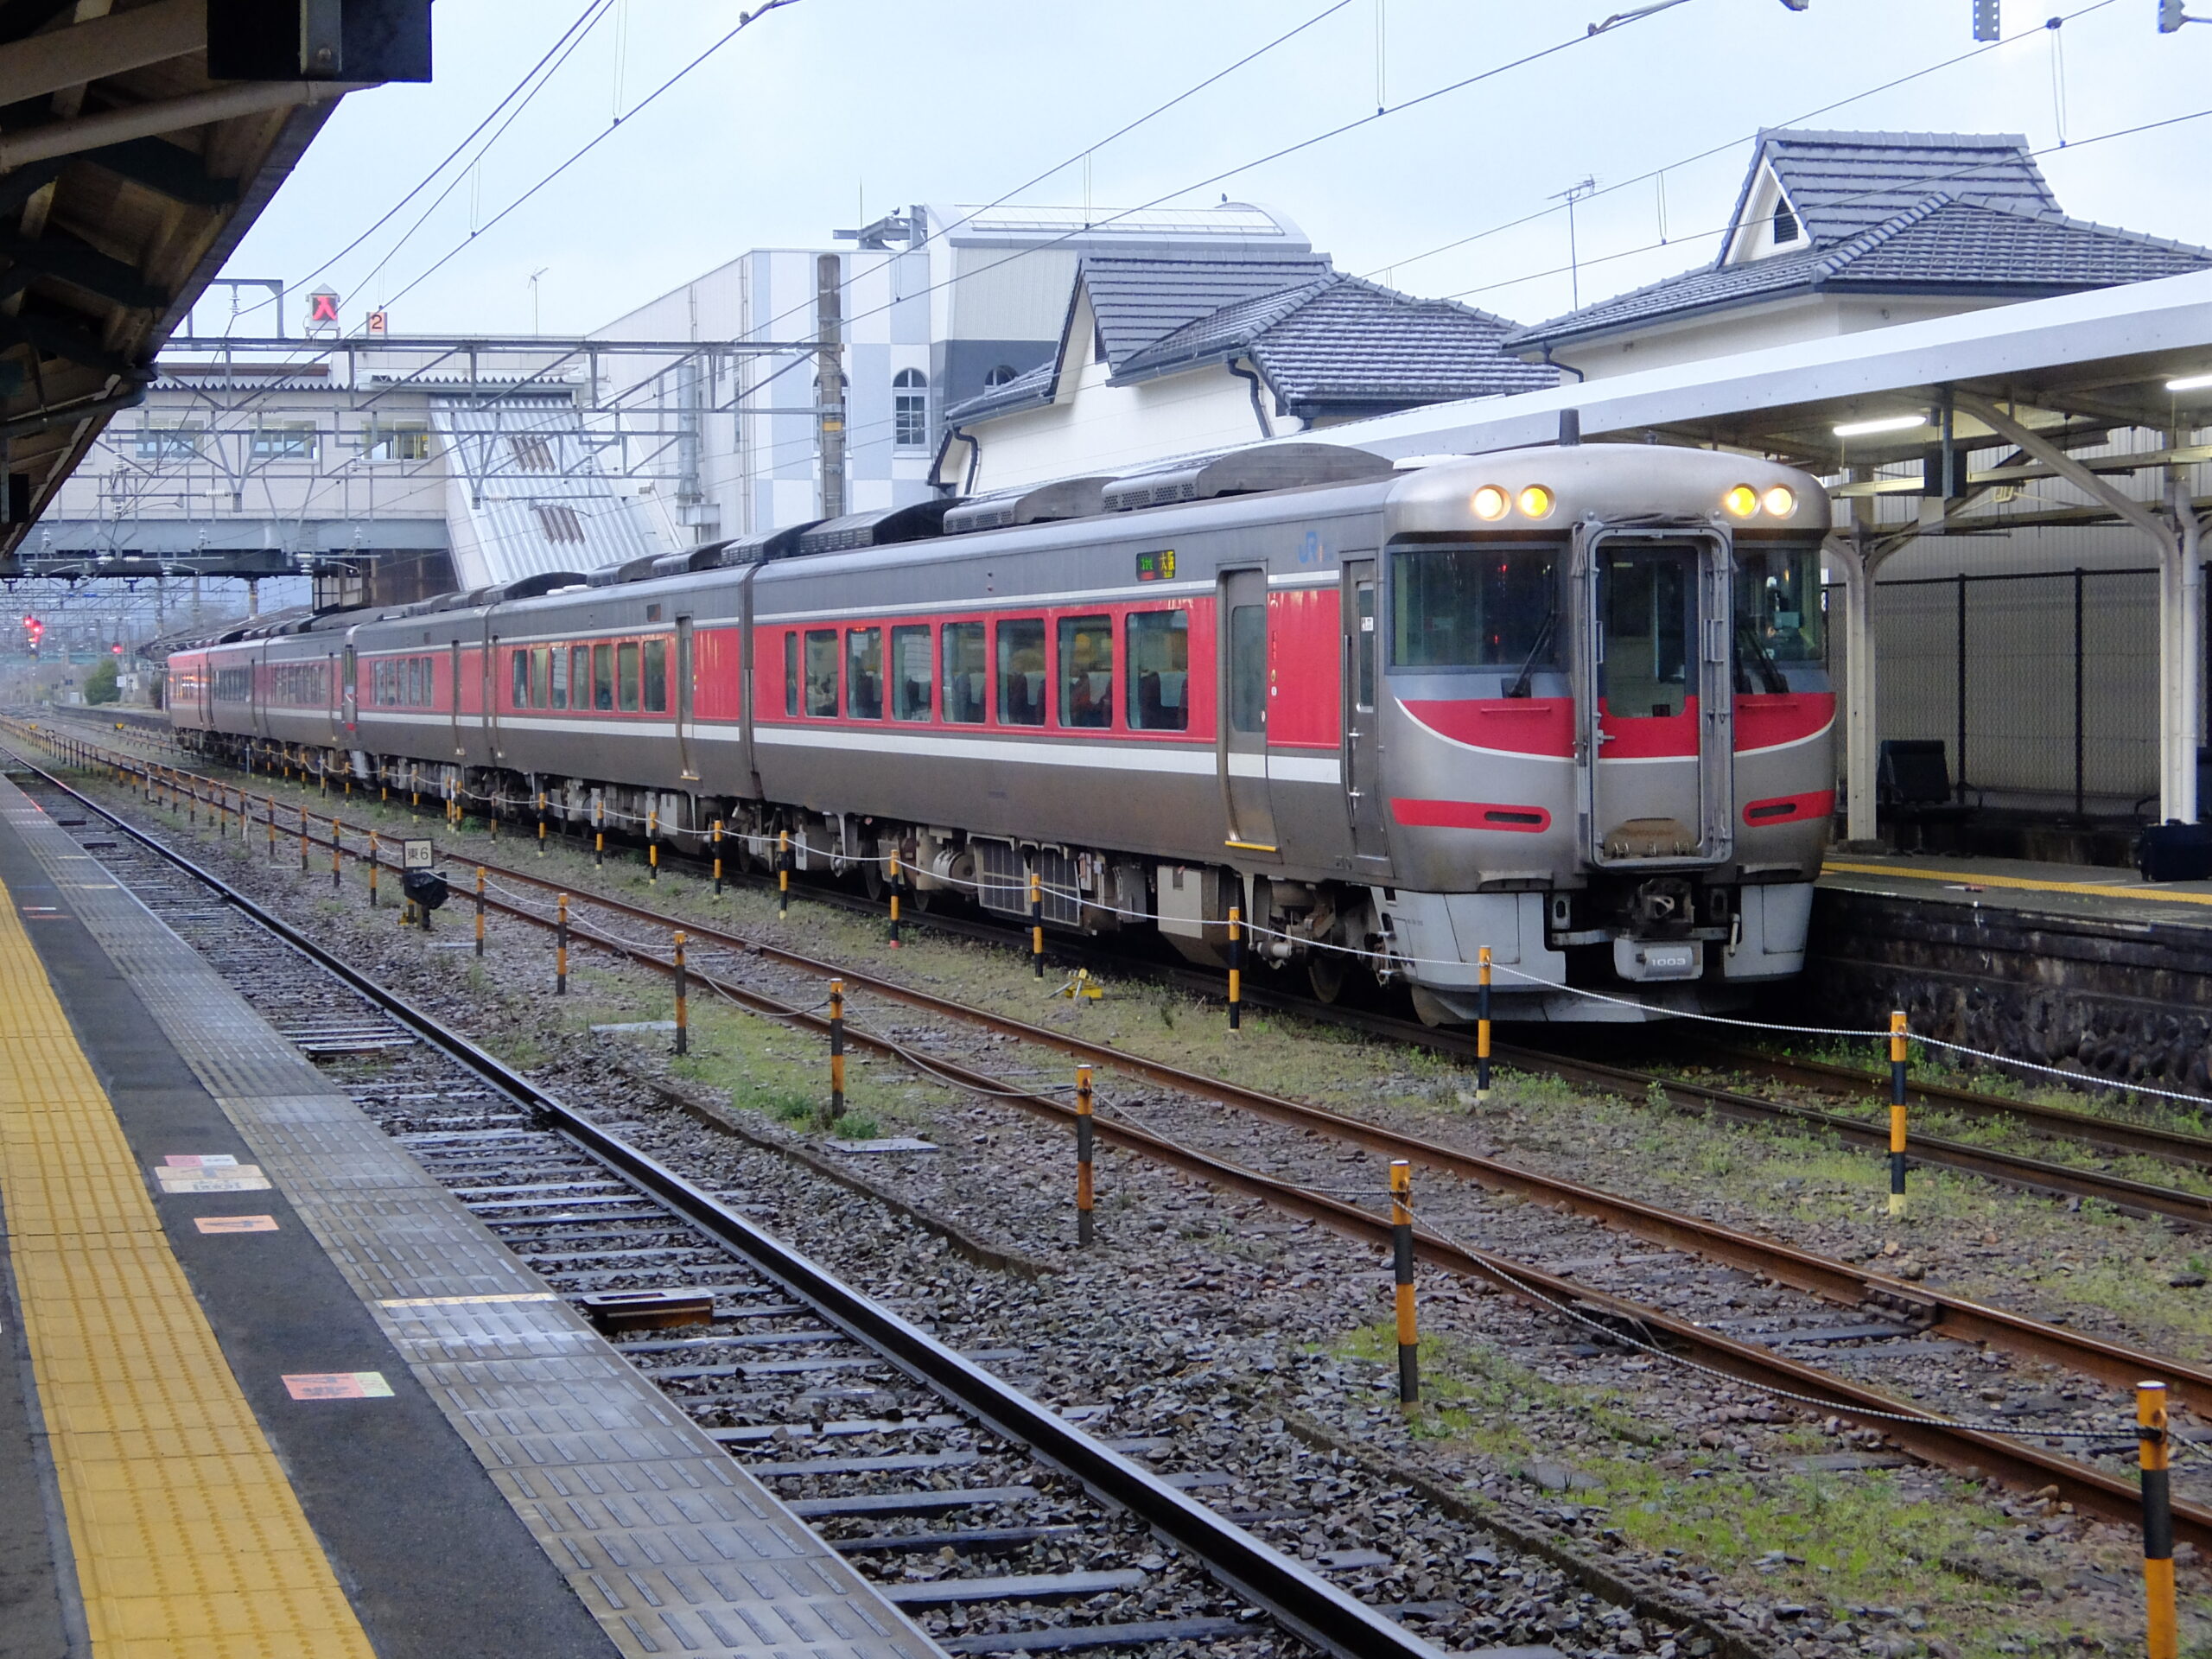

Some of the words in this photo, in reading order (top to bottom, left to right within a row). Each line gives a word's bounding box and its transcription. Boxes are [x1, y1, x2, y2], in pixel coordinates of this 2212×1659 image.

[371, 314, 383, 329] 2
[407, 847, 429, 860] 東6
[1651, 957, 1686, 966] 1003
